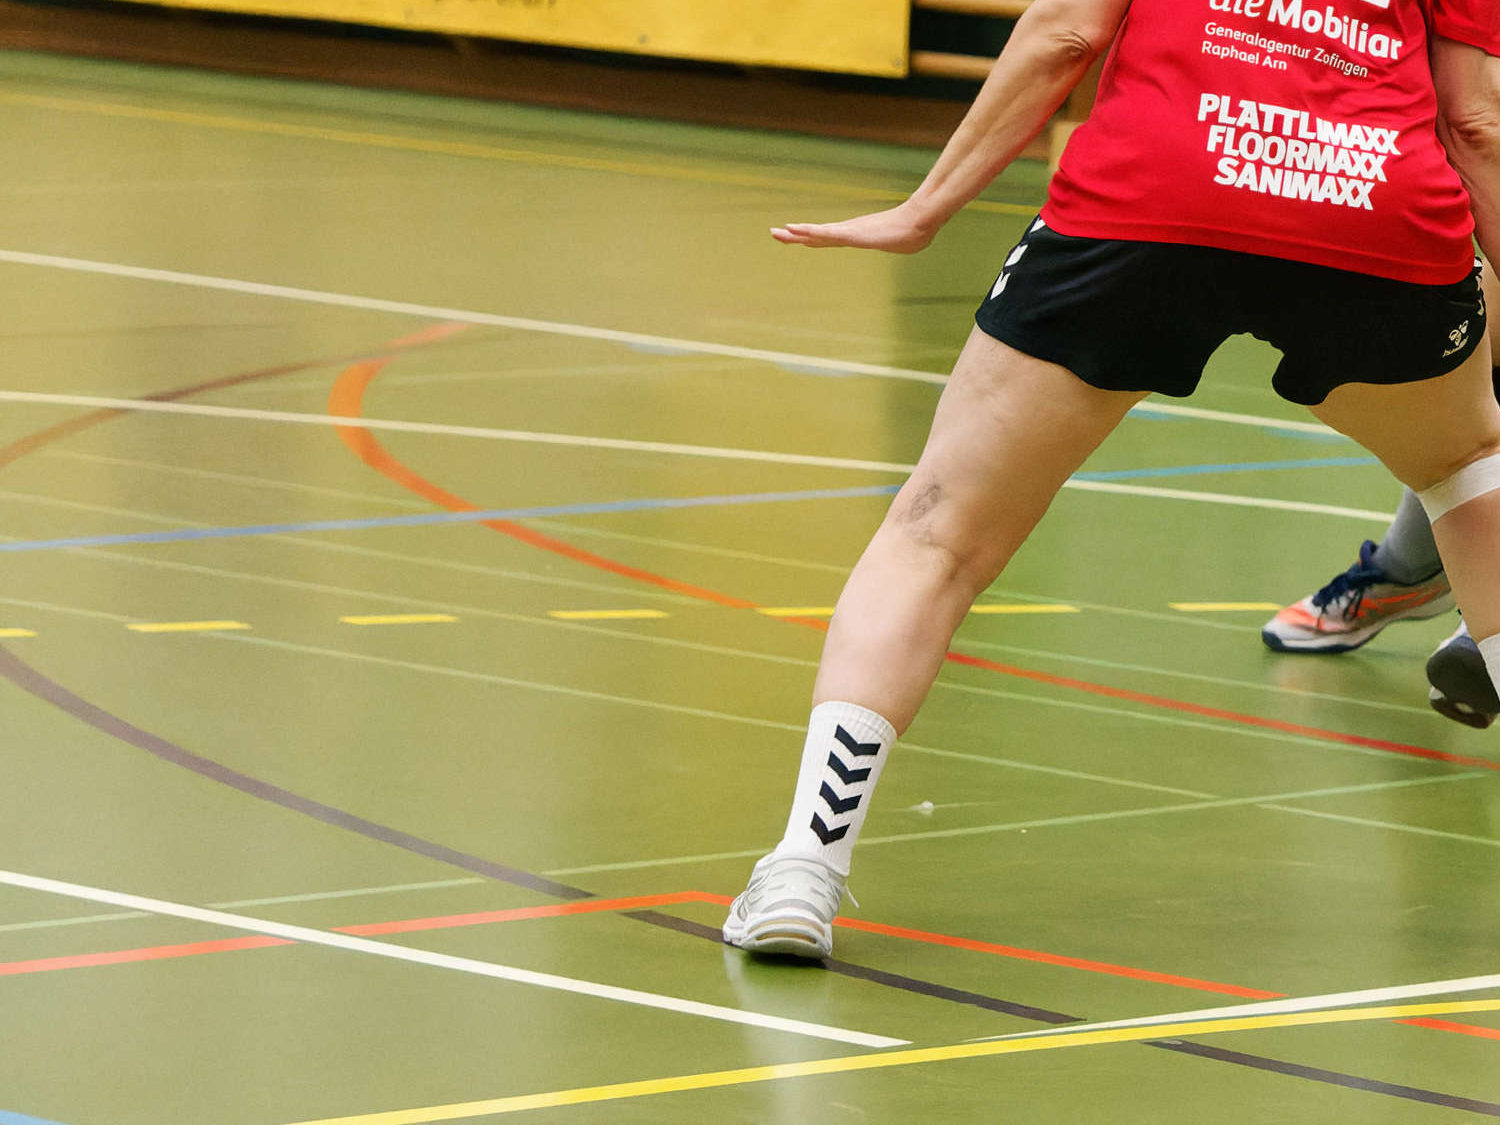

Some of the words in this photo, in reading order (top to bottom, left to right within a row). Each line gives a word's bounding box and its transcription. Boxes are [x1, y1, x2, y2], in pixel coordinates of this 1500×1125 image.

[1201, 41, 1260, 65] Raphael
[1262, 56, 1287, 70] Arn
[1205, 22, 1311, 59] Generalagentur
[1313, 47, 1368, 78] Zofingen
[1207, 125, 1387, 182] FLOORMAXX
[1213, 157, 1375, 210] SANIMAXX
